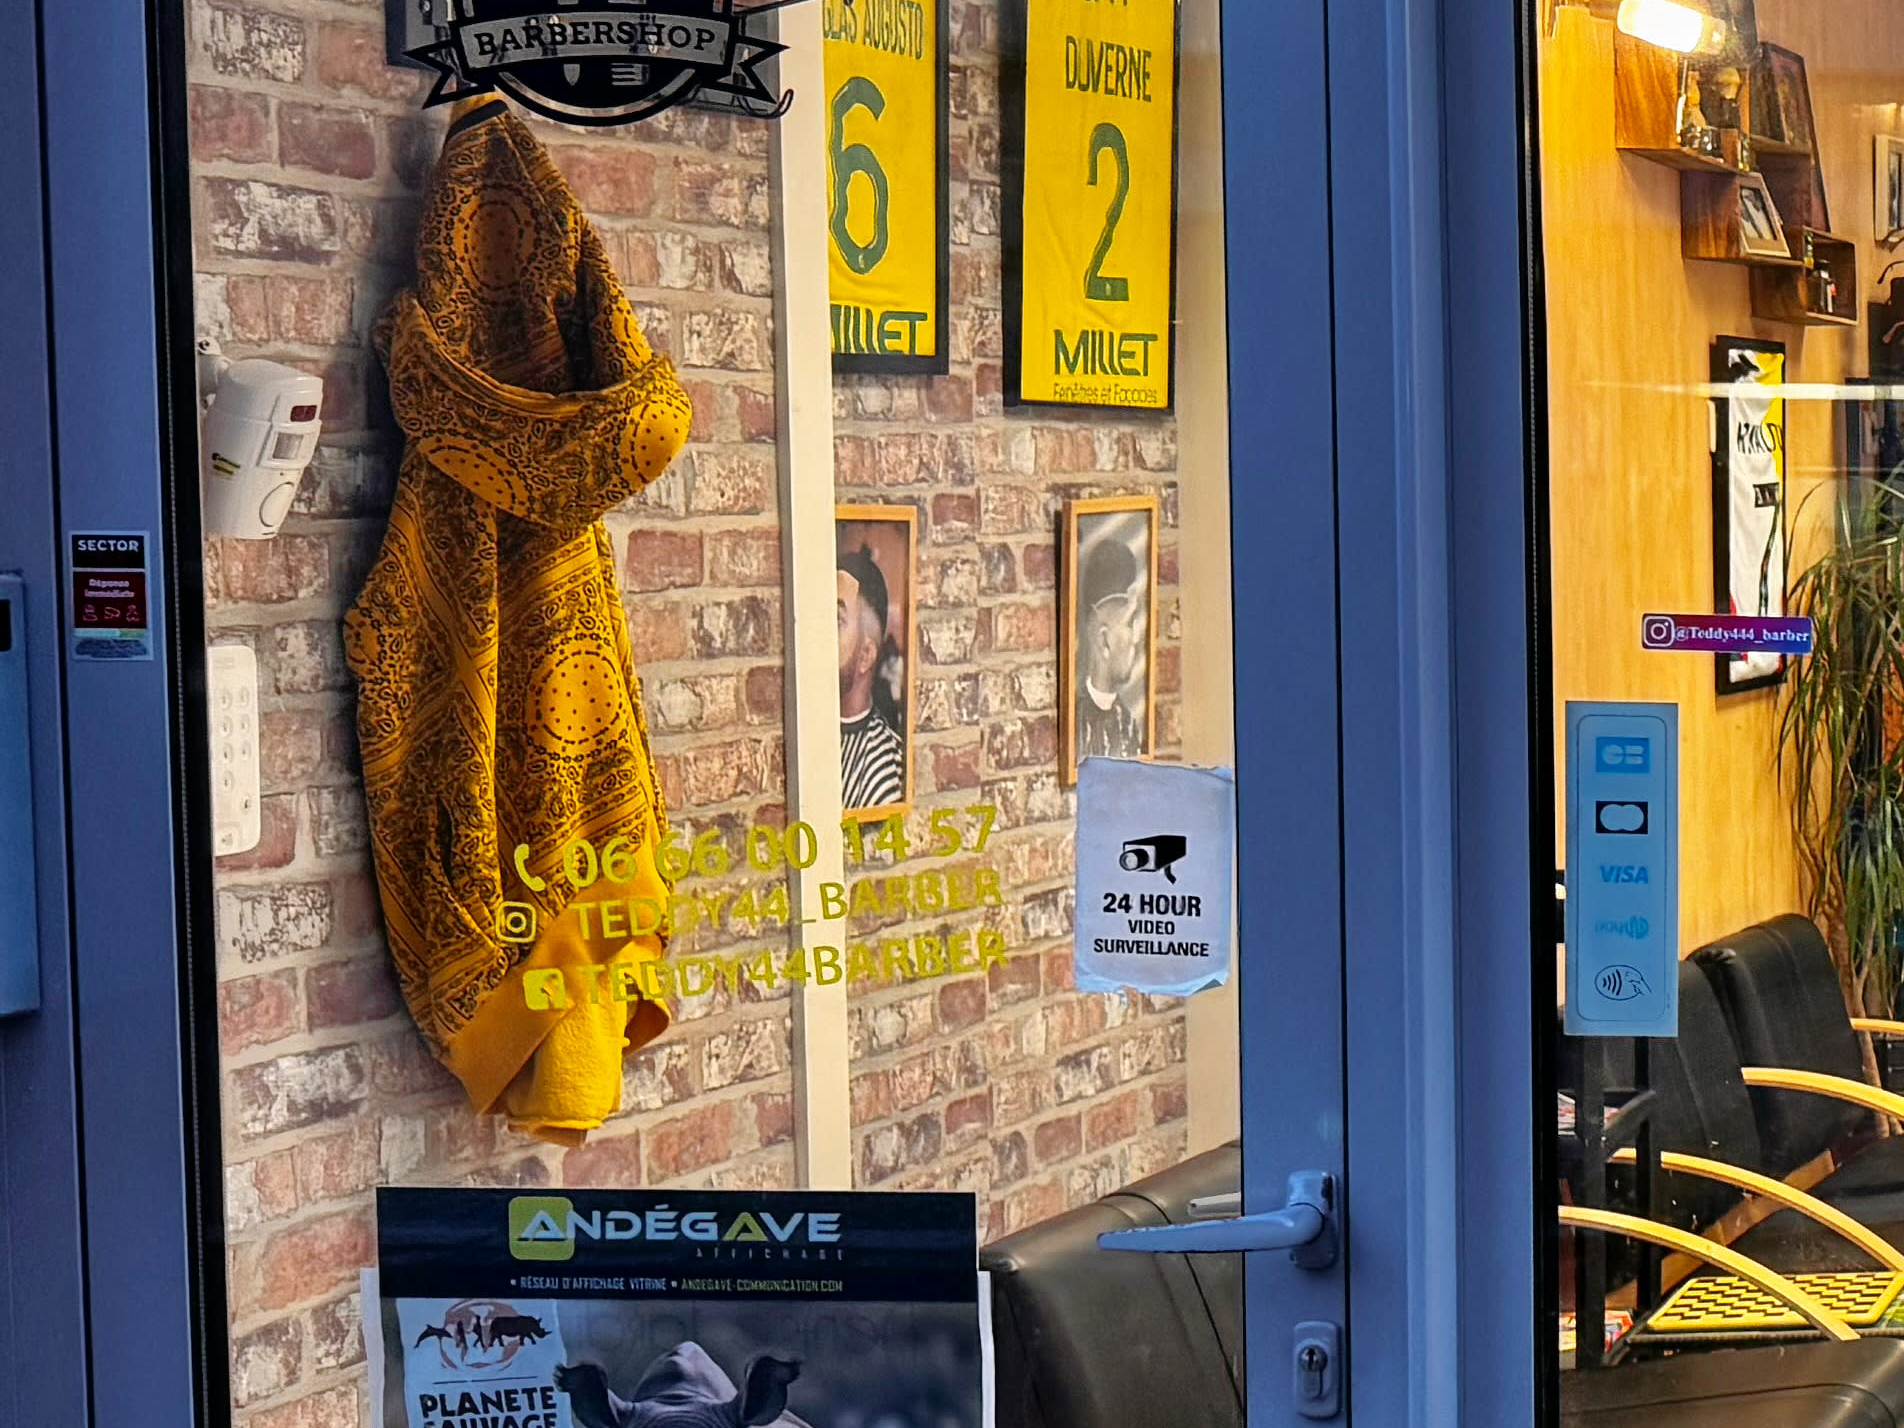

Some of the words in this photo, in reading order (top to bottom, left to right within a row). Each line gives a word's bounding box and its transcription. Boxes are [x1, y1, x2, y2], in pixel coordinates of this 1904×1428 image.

[474, 21, 716, 56] BARBERSHOP
[1065, 35, 1152, 103] DUVERNE
[829, 76, 889, 275] 6
[1084, 122, 1130, 302] 2
[1053, 328, 1159, 377] MILLET
[78, 539, 139, 552] SECTOR
[563, 838, 638, 888] 06
[656, 828, 730, 881] 66
[747, 821, 818, 871] 00
[840, 812, 911, 864] 14
[930, 805, 997, 857] 57
[1600, 866, 1649, 884] VISA
[1103, 892, 1133, 913] 24
[1140, 893, 1201, 917] HOUR
[1128, 919, 1175, 935] VIDEO
[1093, 938, 1210, 957] SURVEILLANCE
[517, 1204, 843, 1243] ANDÉGAVE
[419, 1386, 557, 1418] PLANETE
